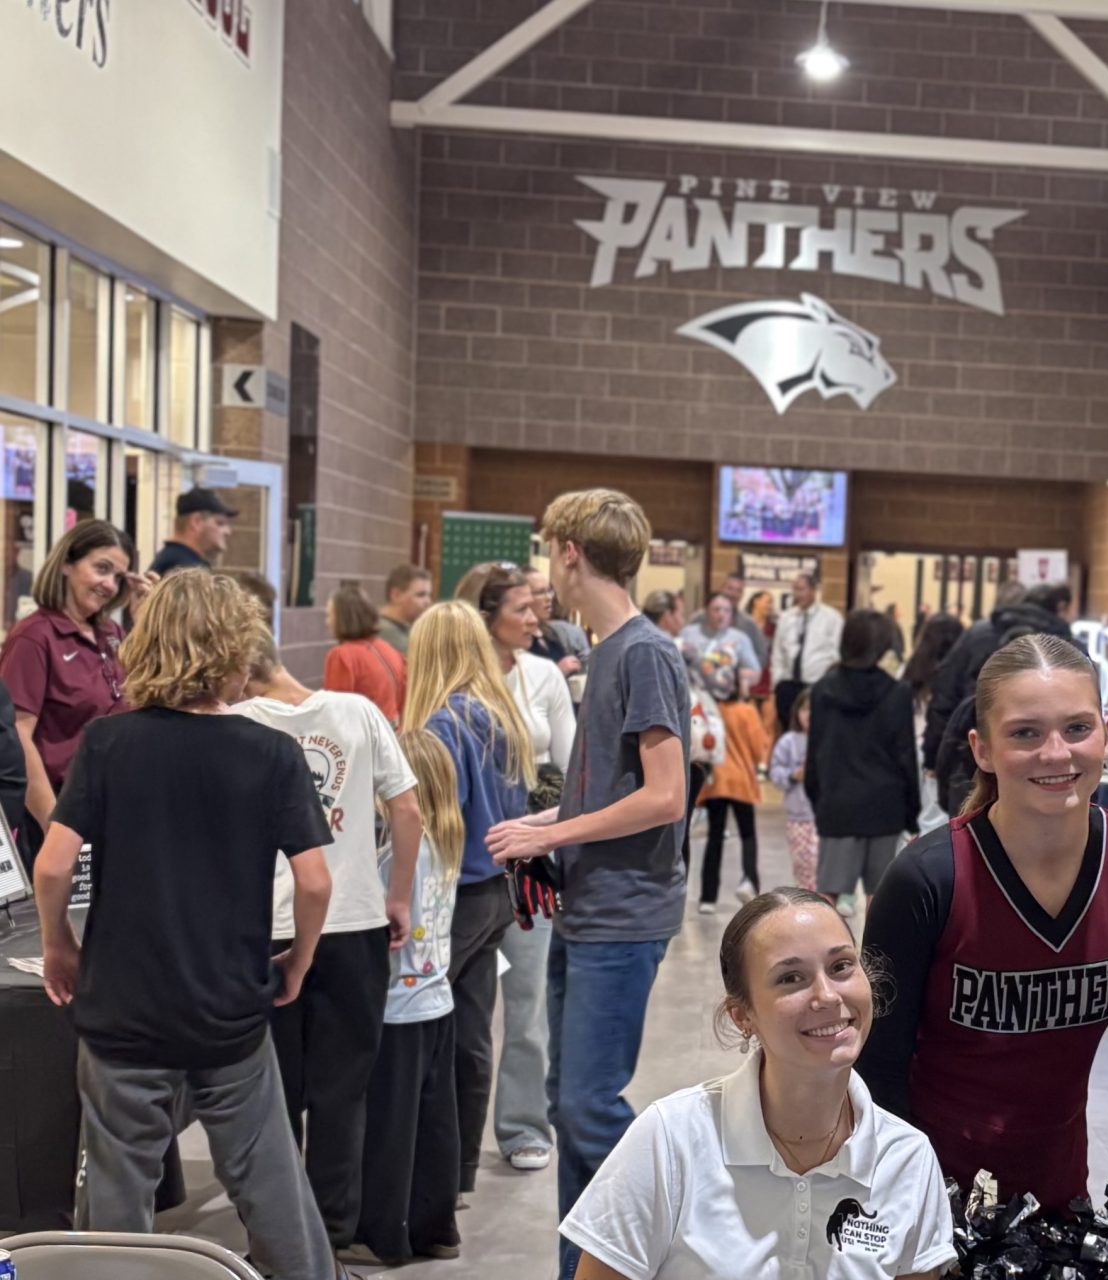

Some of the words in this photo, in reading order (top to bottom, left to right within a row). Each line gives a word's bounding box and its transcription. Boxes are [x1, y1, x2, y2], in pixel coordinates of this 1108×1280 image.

[679, 174, 790, 199] PINE
[822, 184, 937, 210] VIEW
[573, 175, 1029, 316] PANTHERS
[308, 735, 343, 760] NEVER
[331, 759, 346, 791] ENDS
[844, 1228, 862, 1238] CAN
[864, 1232, 886, 1243] STOP
[847, 1219, 889, 1234] NOTHING
